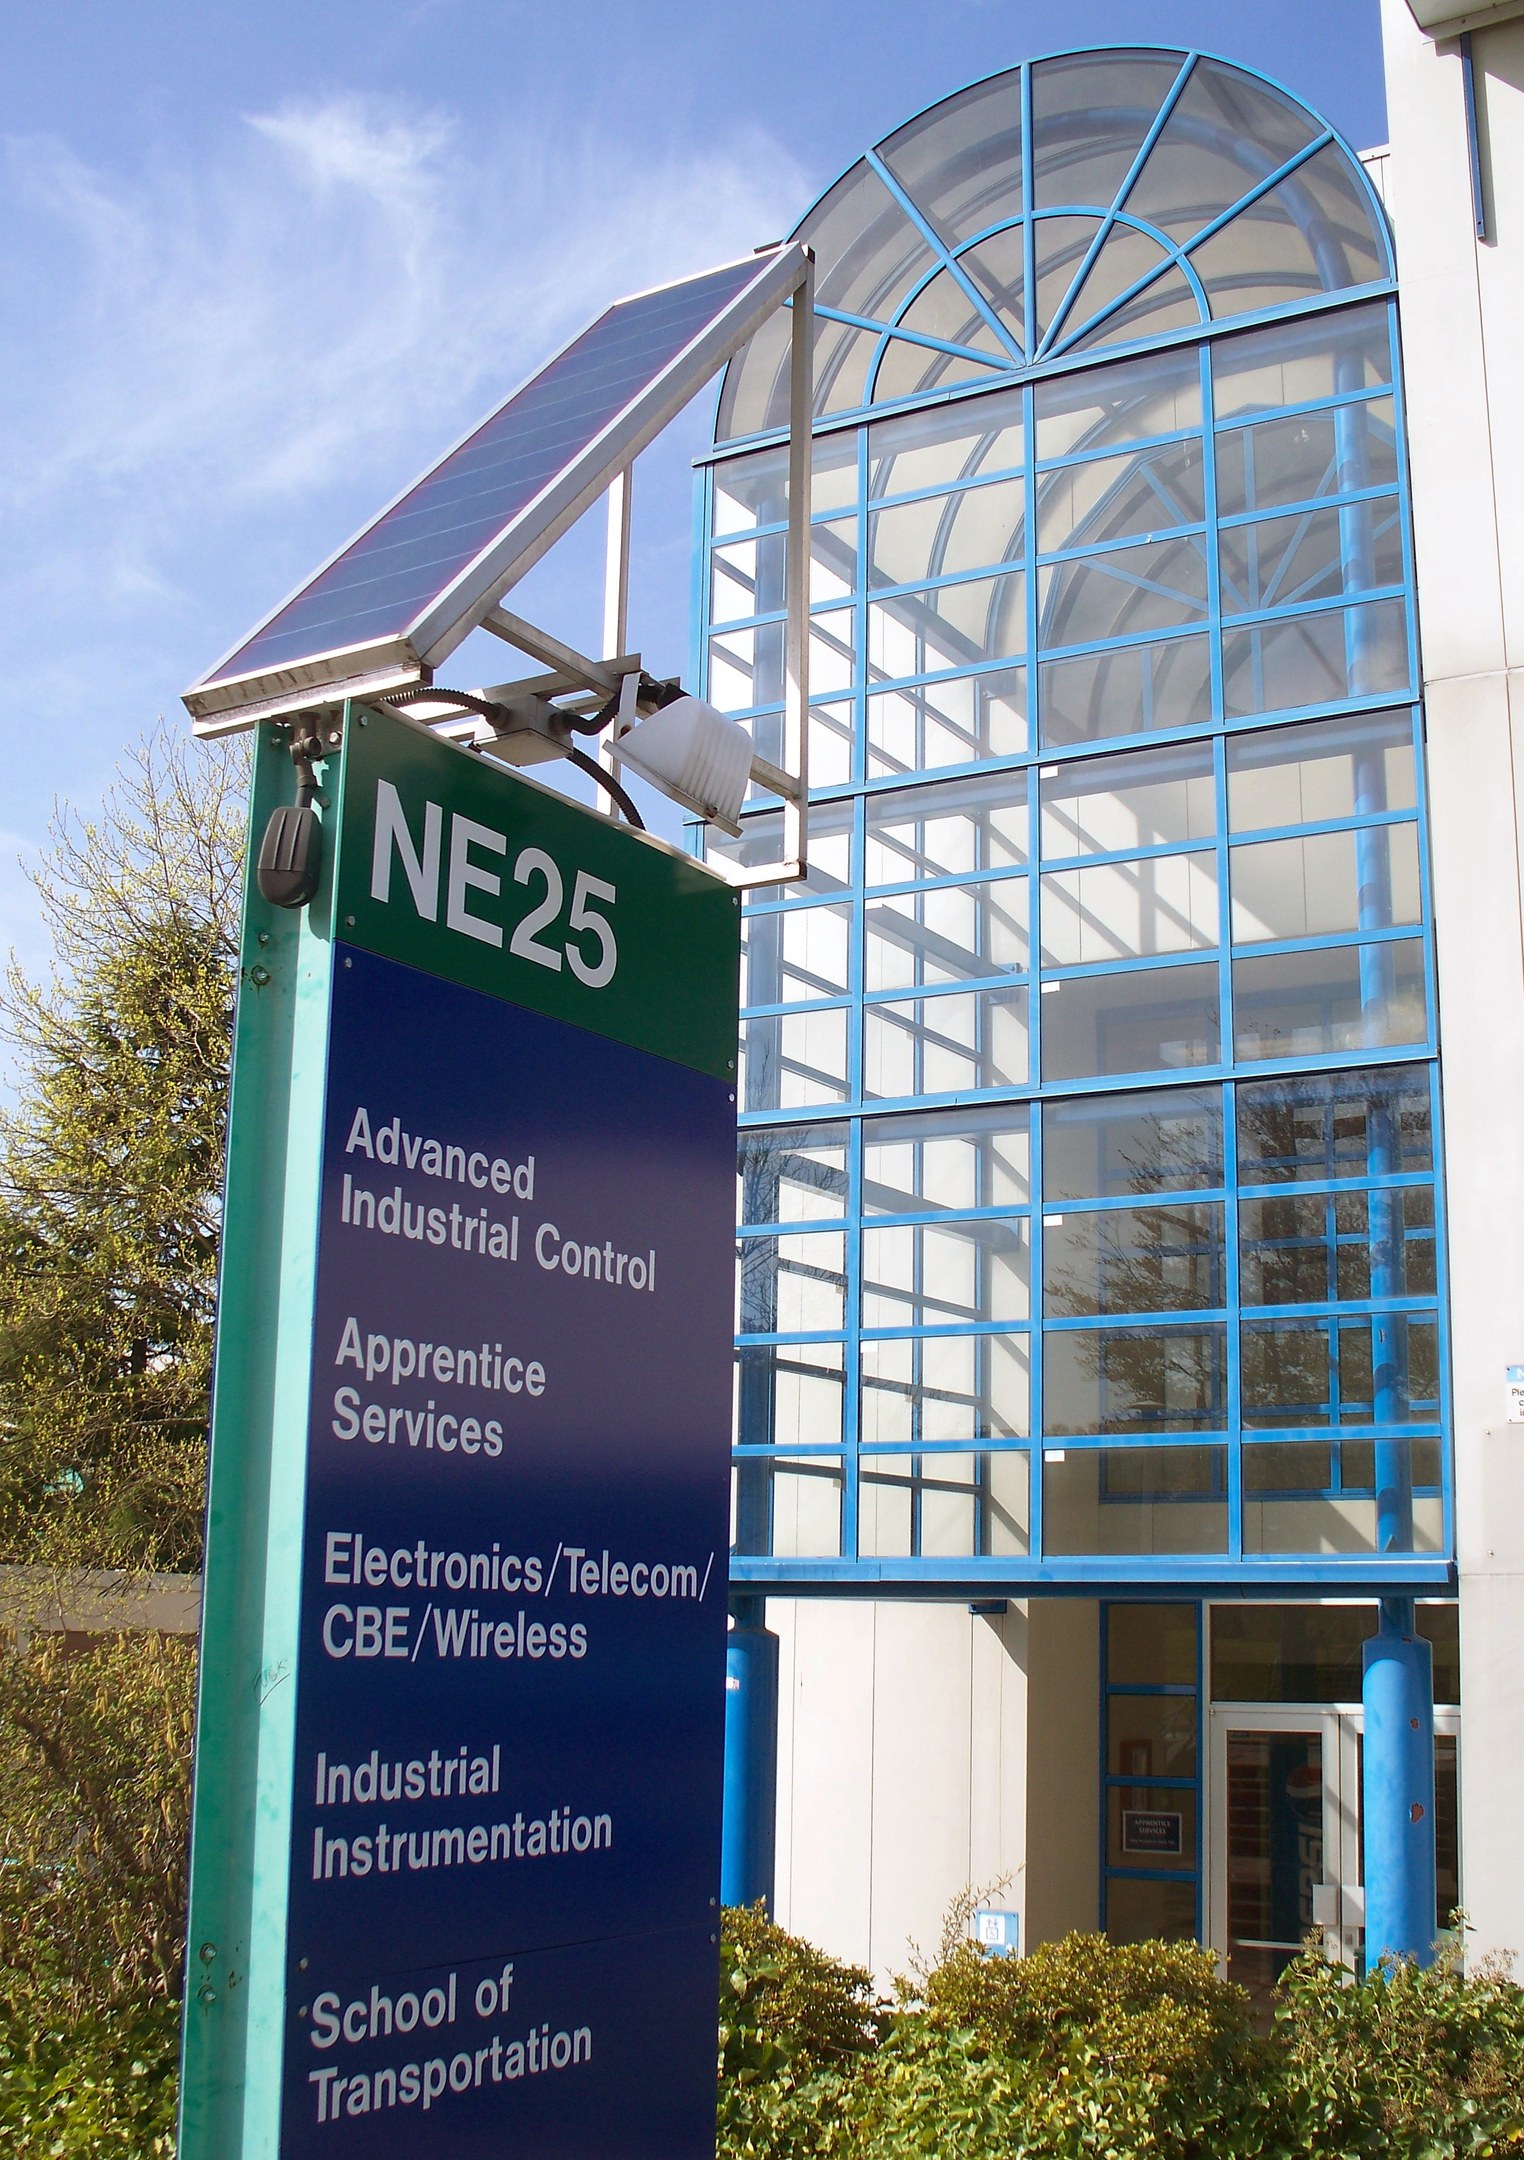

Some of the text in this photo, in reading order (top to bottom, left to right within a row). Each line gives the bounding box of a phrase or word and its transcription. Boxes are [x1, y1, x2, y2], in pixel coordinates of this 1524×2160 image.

[370, 778, 617, 988] NE25
[345, 1106, 535, 1201] Advanced
[341, 1173, 656, 1292] Industrial Control
[334, 1316, 546, 1397] Apprentice
[332, 1386, 504, 1457] Services
[324, 1532, 714, 1602] Electronics/Telecom/
[323, 1603, 587, 1663] CBE/Wireless
[316, 1744, 500, 1805] Industrial
[313, 1806, 612, 1880] Instrumentation
[311, 1963, 514, 2048] School of
[308, 2022, 592, 2122] Transportation
